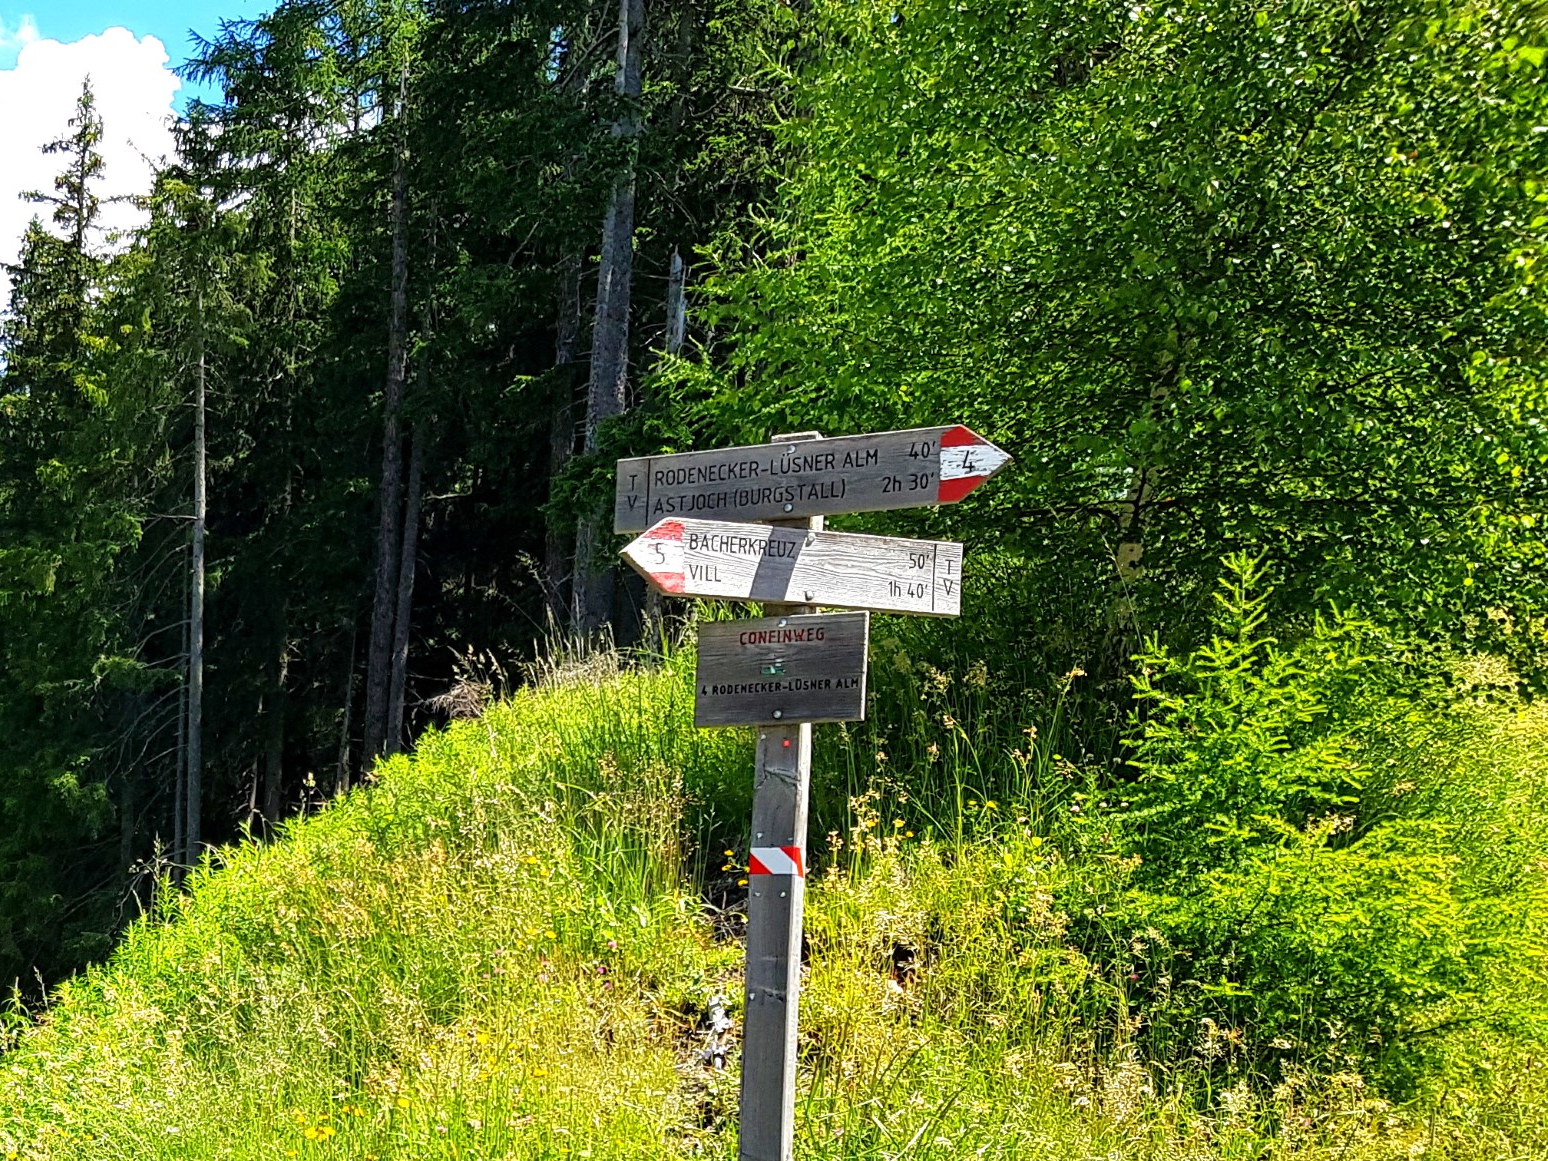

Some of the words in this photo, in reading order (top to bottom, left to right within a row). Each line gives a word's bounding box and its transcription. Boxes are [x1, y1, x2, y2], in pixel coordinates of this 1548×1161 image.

[629, 474, 638, 492] T
[654, 453, 835, 487] RODENECKER-LÜSNER
[842, 448, 878, 469] ALM
[962, 450, 975, 473] 4
[627, 494, 638, 512] V
[653, 491, 727, 514] ASTJOCH
[733, 478, 846, 508] (BURGSTALL)
[882, 475, 901, 493] 2h
[656, 542, 665, 564] 5
[689, 533, 796, 559] BACHERKREUZ
[944, 559, 954, 575] T
[688, 565, 722, 582] VILL
[943, 579, 954, 596] V
[835, 678, 859, 689] ALM
